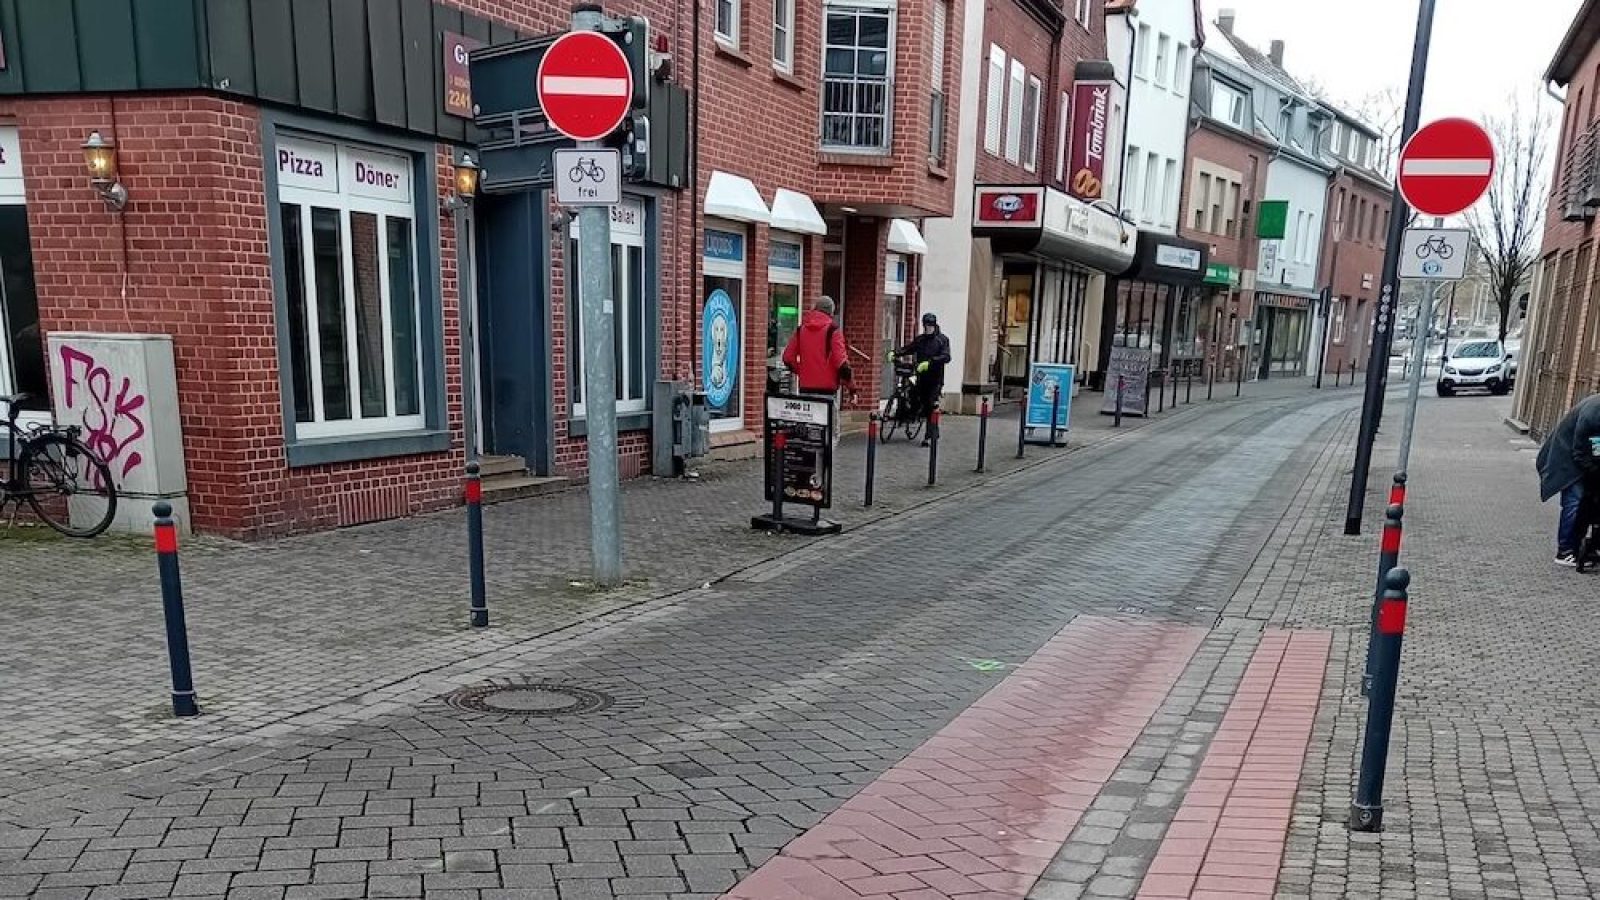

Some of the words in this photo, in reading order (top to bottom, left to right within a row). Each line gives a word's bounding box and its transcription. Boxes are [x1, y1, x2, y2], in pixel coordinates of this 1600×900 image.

[278, 149, 323, 177] Pizza
[355, 161, 400, 189] Döner
[578, 186, 598, 197] frei
